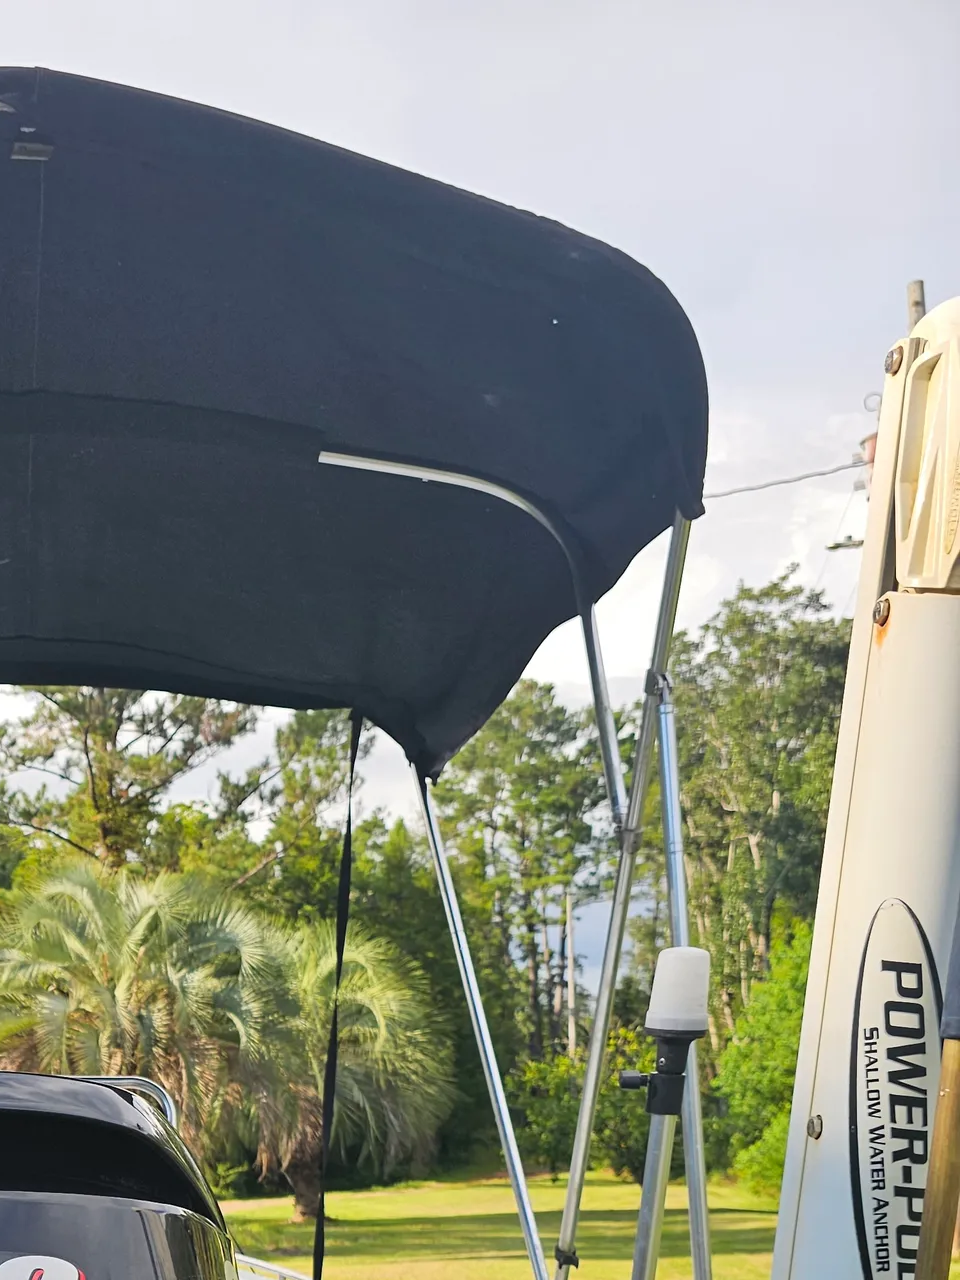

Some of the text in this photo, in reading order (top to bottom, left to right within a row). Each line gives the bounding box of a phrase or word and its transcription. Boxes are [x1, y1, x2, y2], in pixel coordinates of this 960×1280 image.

[863, 1027, 890, 1272] SHALLOW WATER ANCHOR
